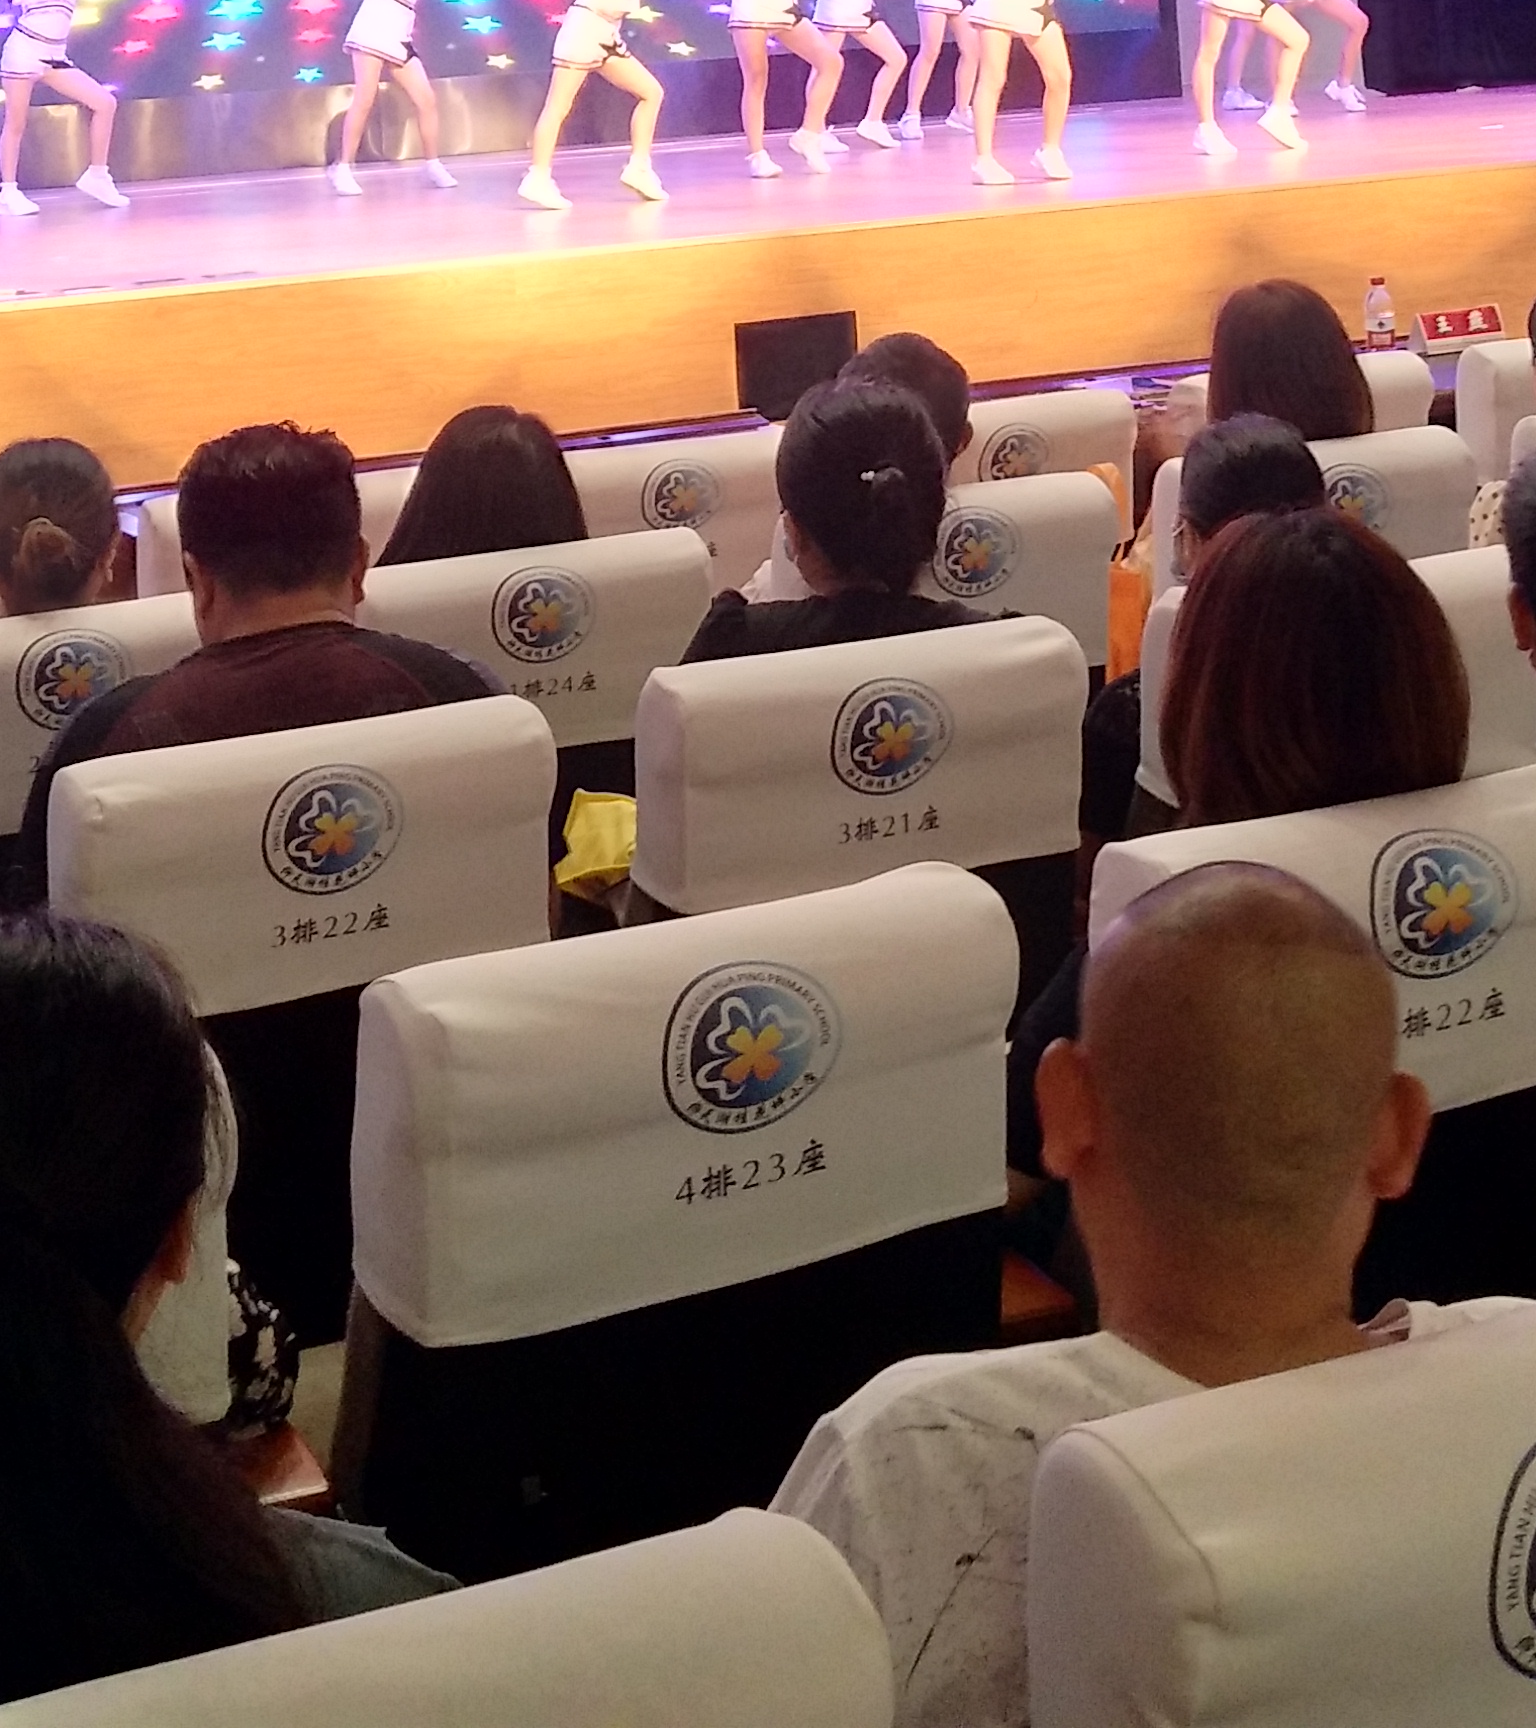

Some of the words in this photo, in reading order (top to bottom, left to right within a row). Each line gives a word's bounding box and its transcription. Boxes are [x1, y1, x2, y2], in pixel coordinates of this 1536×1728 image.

[838, 804, 940, 845] 3排21座
[271, 903, 390, 948] 3排22座
[1402, 987, 1506, 1039] 排22座
[675, 1139, 827, 1205] 4排23座
